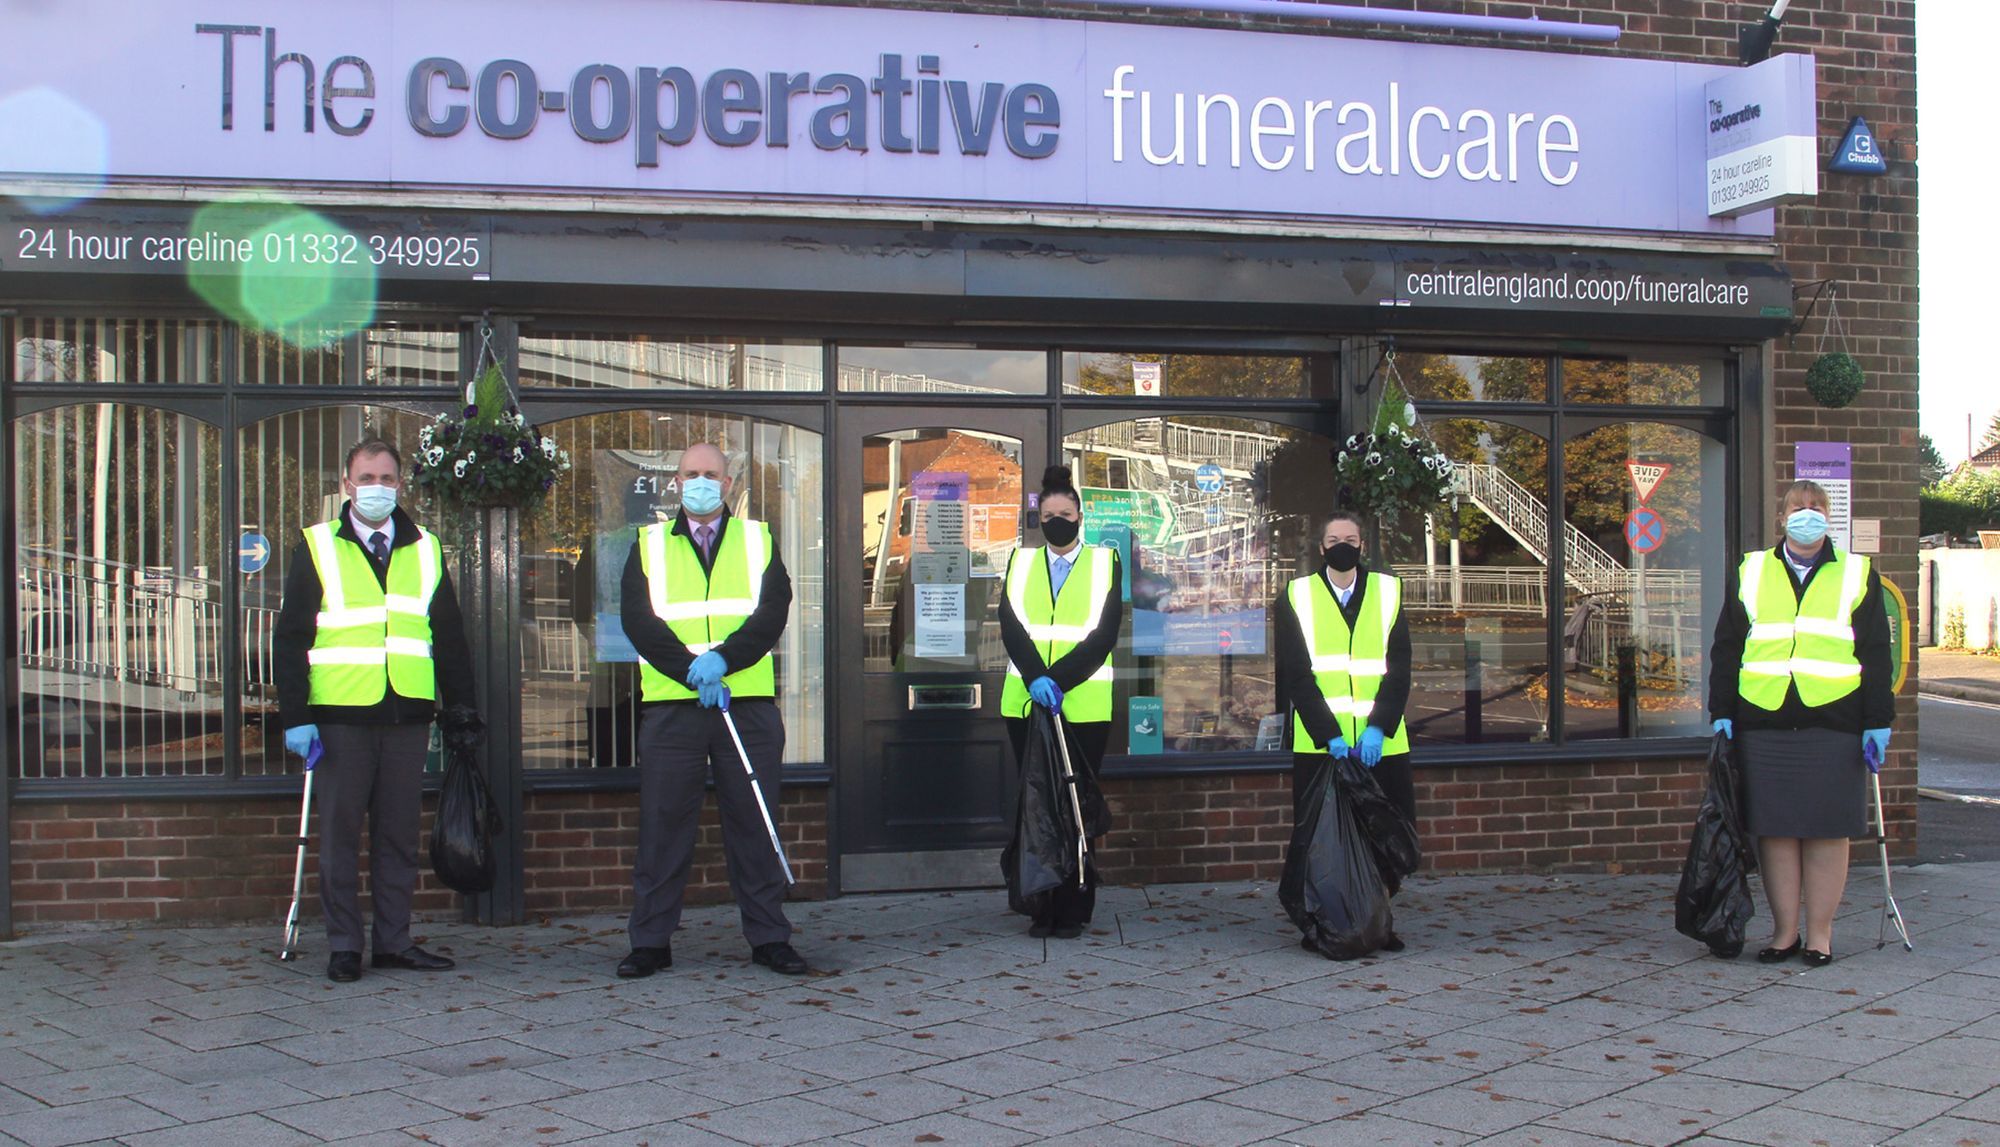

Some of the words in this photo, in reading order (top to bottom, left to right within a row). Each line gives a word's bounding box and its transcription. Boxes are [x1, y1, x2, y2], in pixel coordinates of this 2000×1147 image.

[195, 23, 375, 137] The
[405, 53, 1061, 168] co-operative
[1103, 64, 1580, 186] funeralcare
[1708, 99, 1723, 116] The
[1710, 103, 1761, 134] co-operative
[1711, 168, 1721, 185] 24
[1723, 164, 1740, 181] hour
[1741, 154, 1772, 175] careline
[1847, 152, 1879, 164] Chubb
[1711, 184, 1737, 206] 01332
[1738, 174, 1770, 198] 349925
[18, 228, 56, 259] 24
[68, 228, 133, 260] hour
[141, 231, 254, 263] careline
[263, 233, 358, 264] 01332
[368, 235, 480, 267] 349925
[1406, 269, 1750, 306] centralengland.coop/funeralcare
[639, 463, 662, 471] Plans
[662, 463, 679, 471] star
[1798, 468, 1831, 477] funeralcare
[633, 476, 678, 497] £1,4
